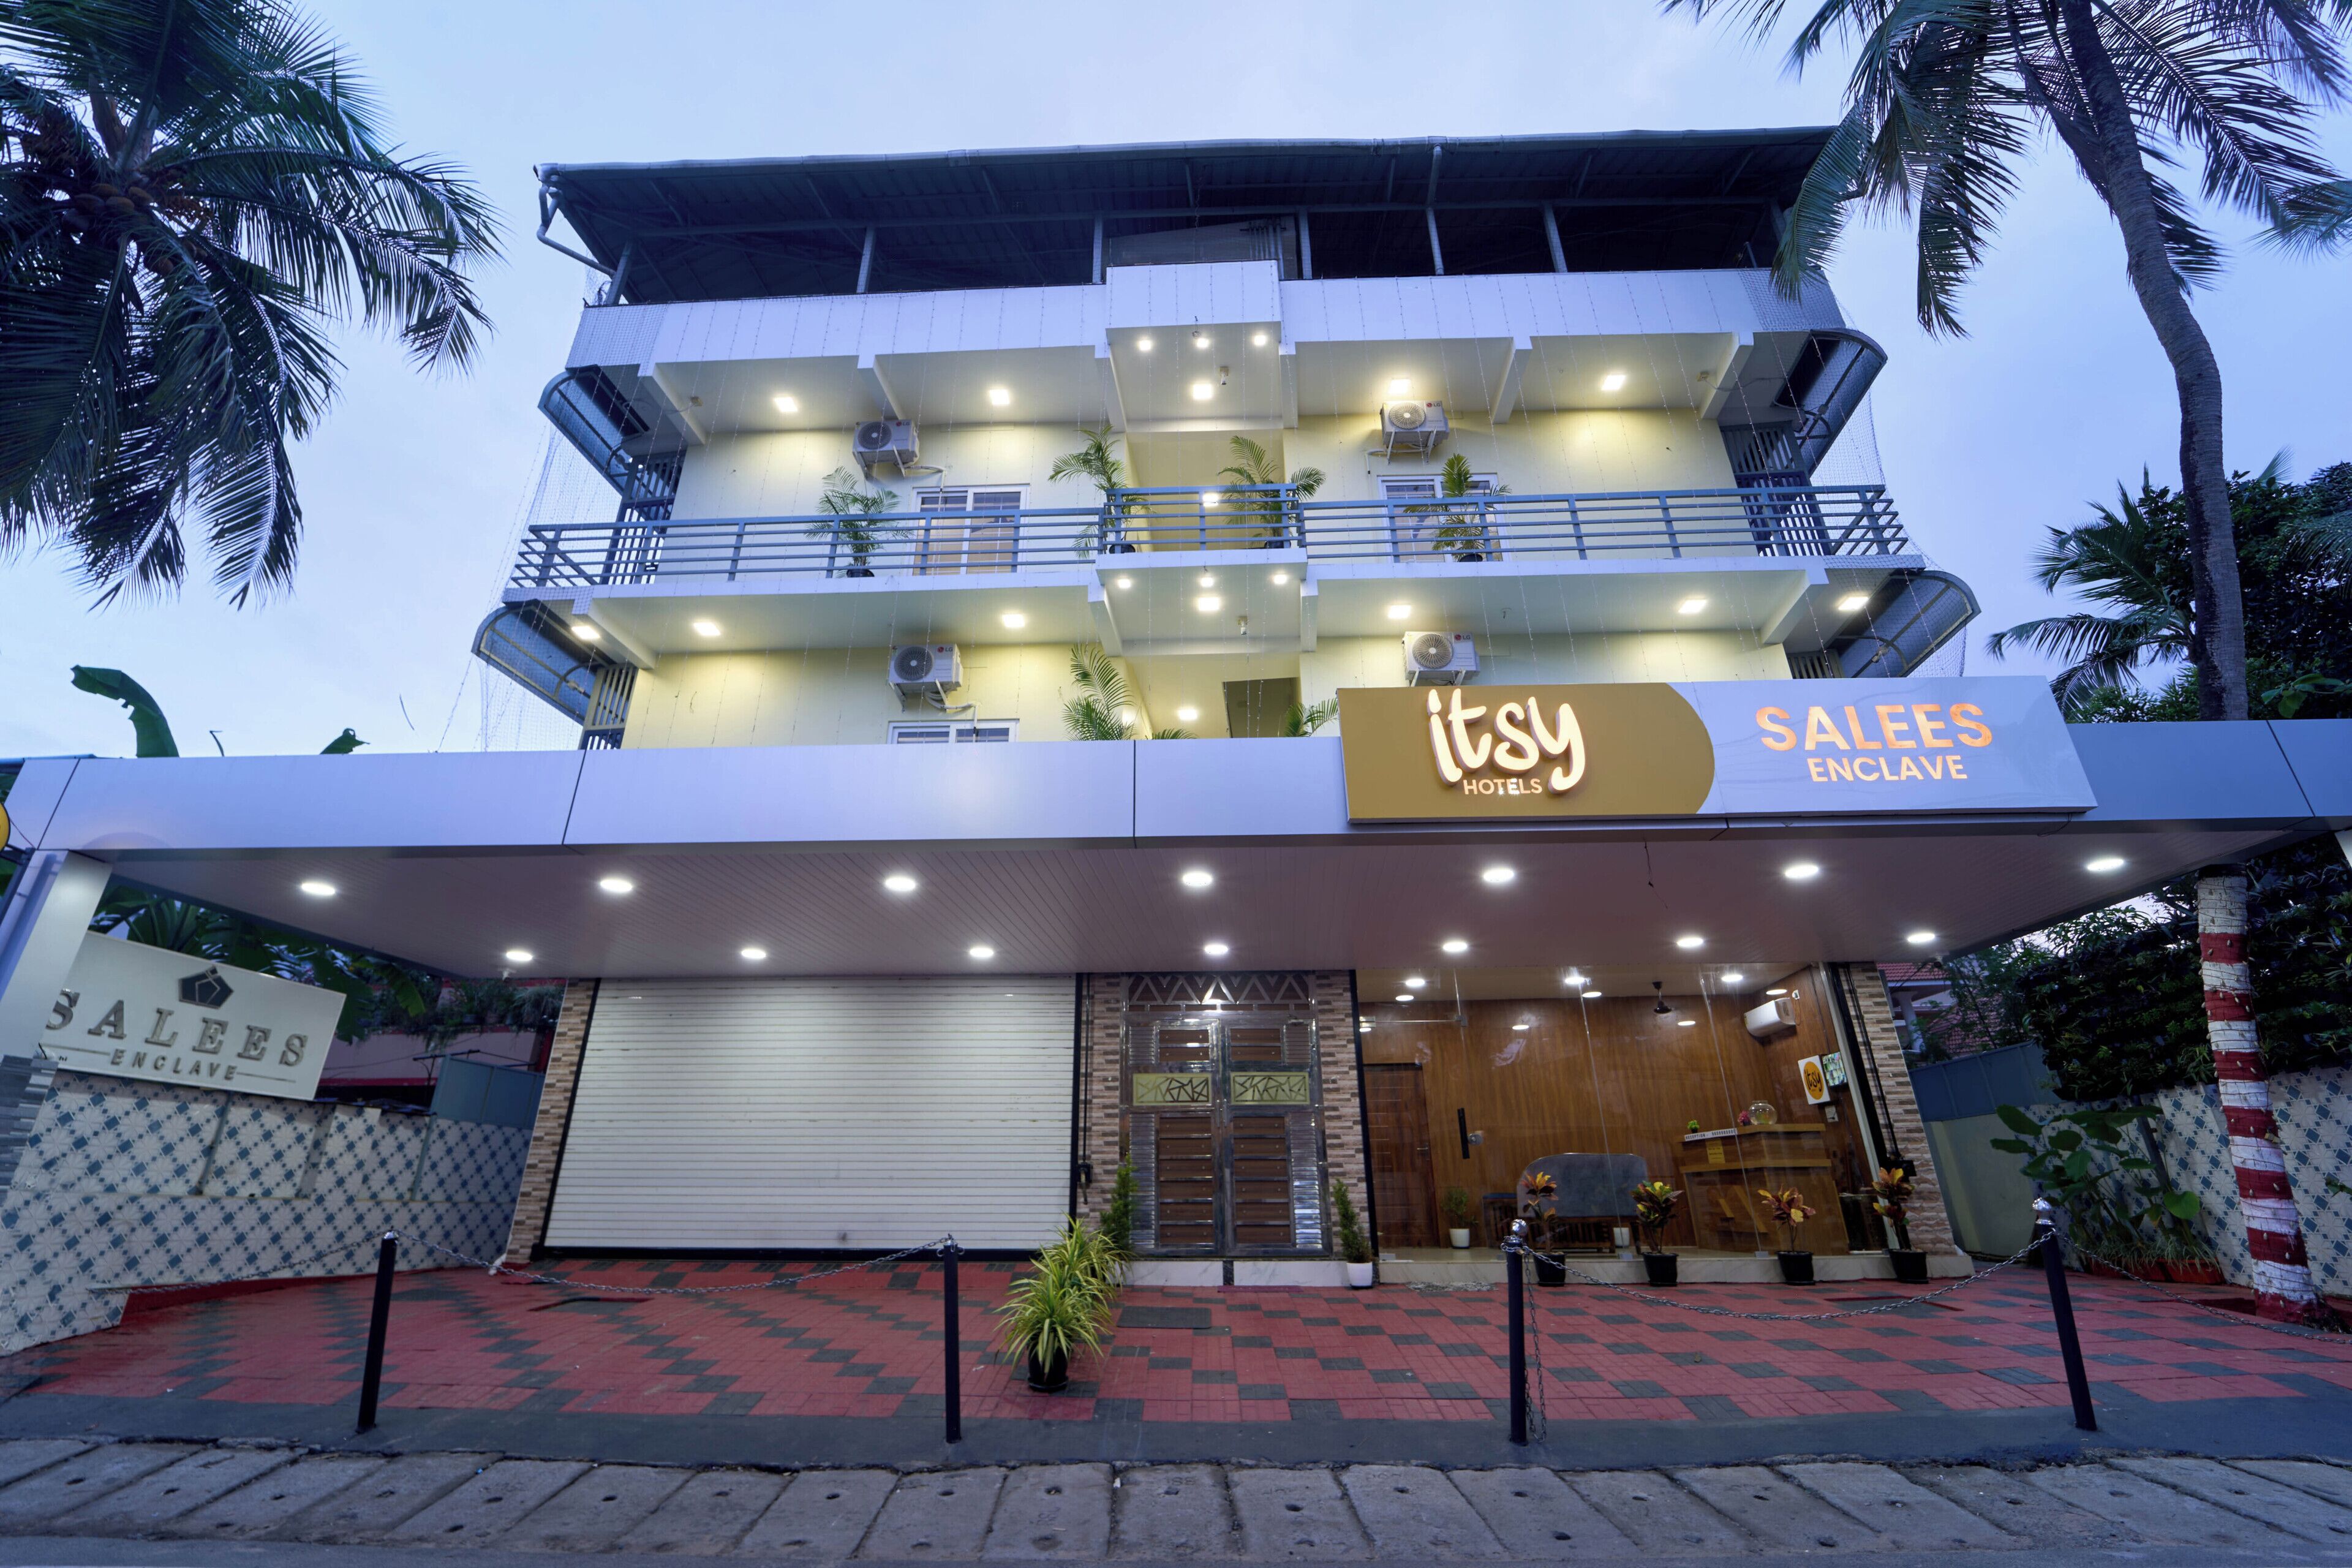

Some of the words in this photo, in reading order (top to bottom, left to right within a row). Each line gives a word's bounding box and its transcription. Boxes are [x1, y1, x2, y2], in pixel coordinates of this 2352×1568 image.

[1427, 688, 1586, 794] itsy
[1755, 703, 1992, 751] SALEES
[1463, 778, 1543, 795] HOTELS
[1807, 755, 1968, 782] ENCLAVE
[45, 988, 308, 1067] SALEES
[110, 1048, 238, 1080] ENCLAVE
